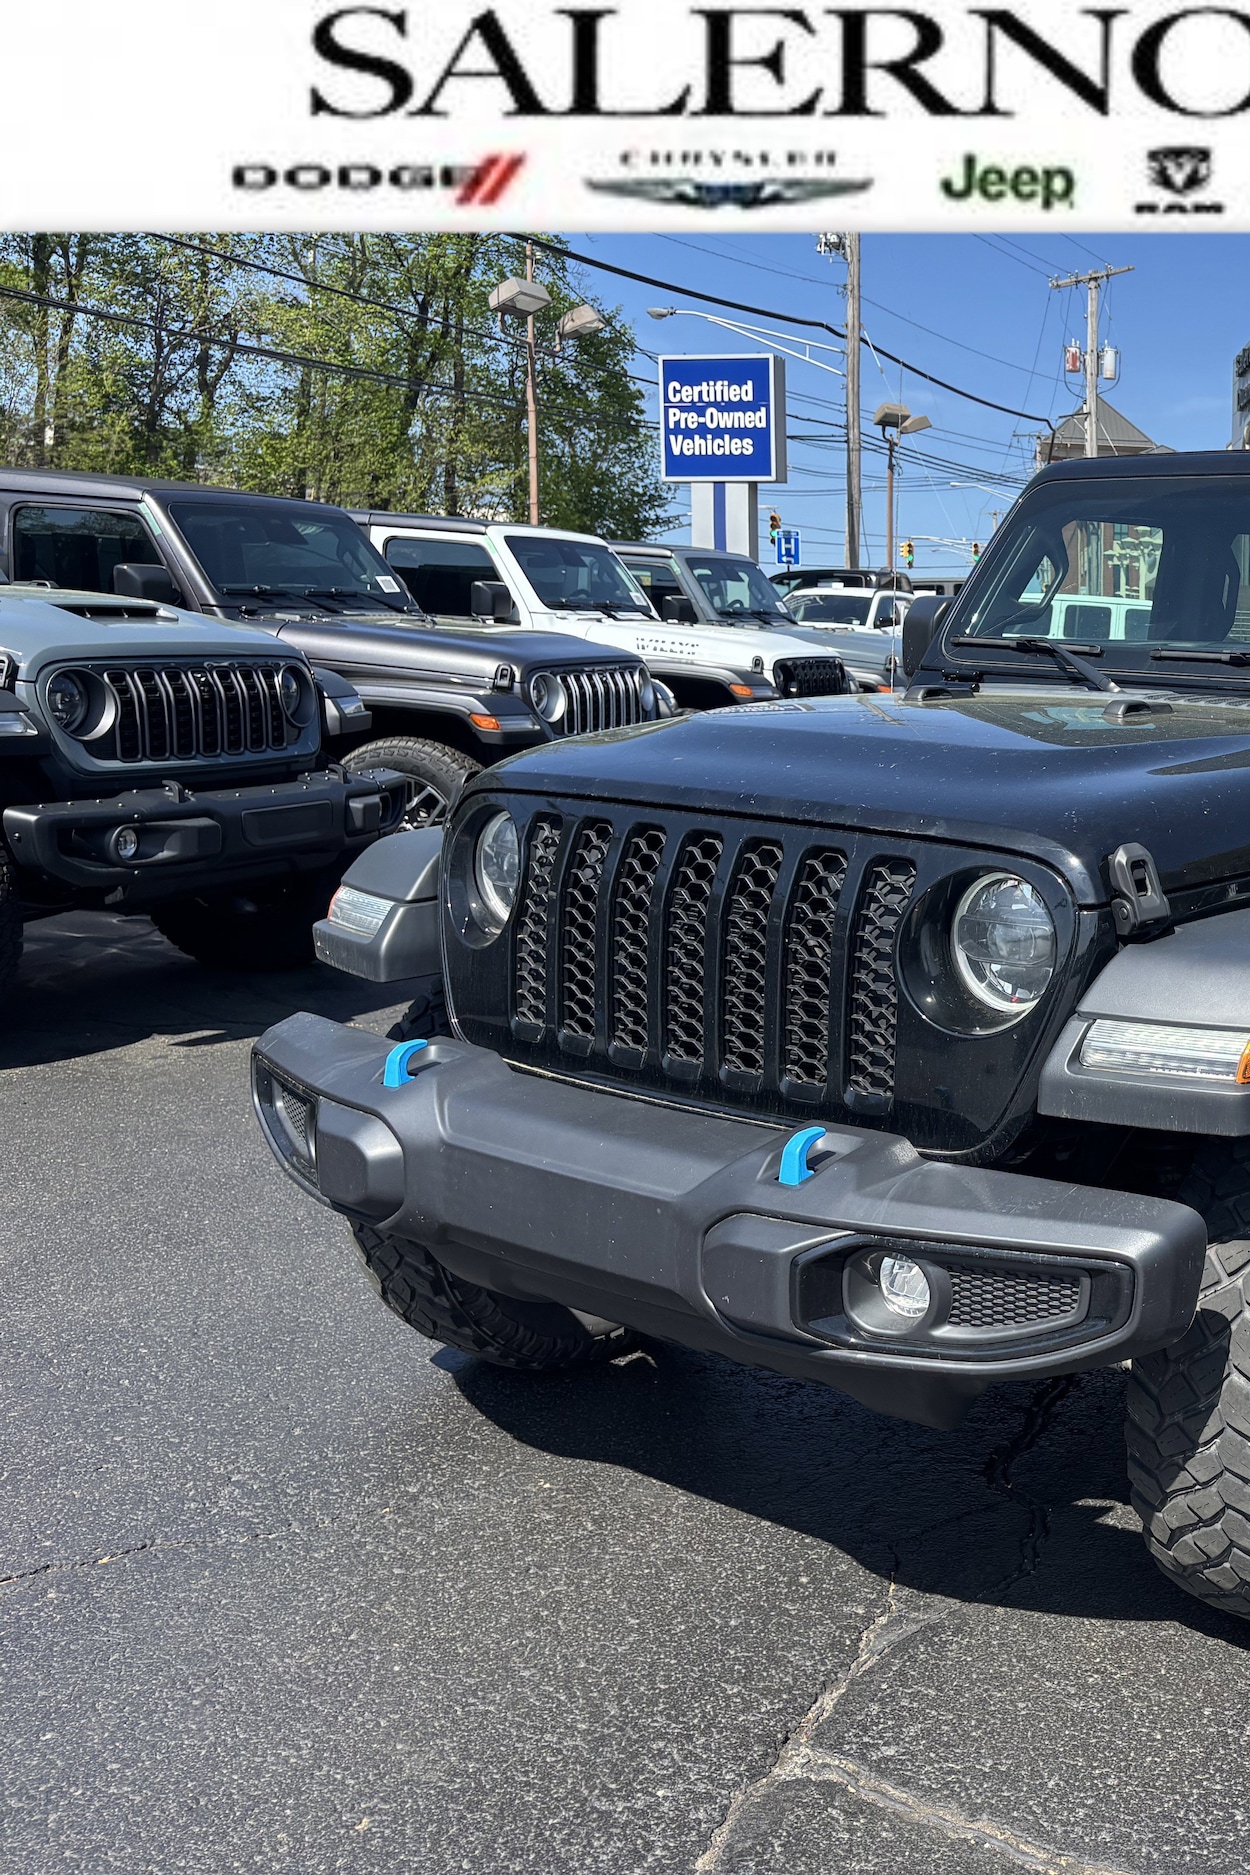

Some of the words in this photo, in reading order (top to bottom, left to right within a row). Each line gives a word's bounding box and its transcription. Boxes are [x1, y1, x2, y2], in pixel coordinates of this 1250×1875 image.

[668, 380, 753, 402] Certified
[668, 407, 767, 429] Pre-Owned
[669, 434, 754, 456] Vehicles
[781, 538, 795, 555] H
